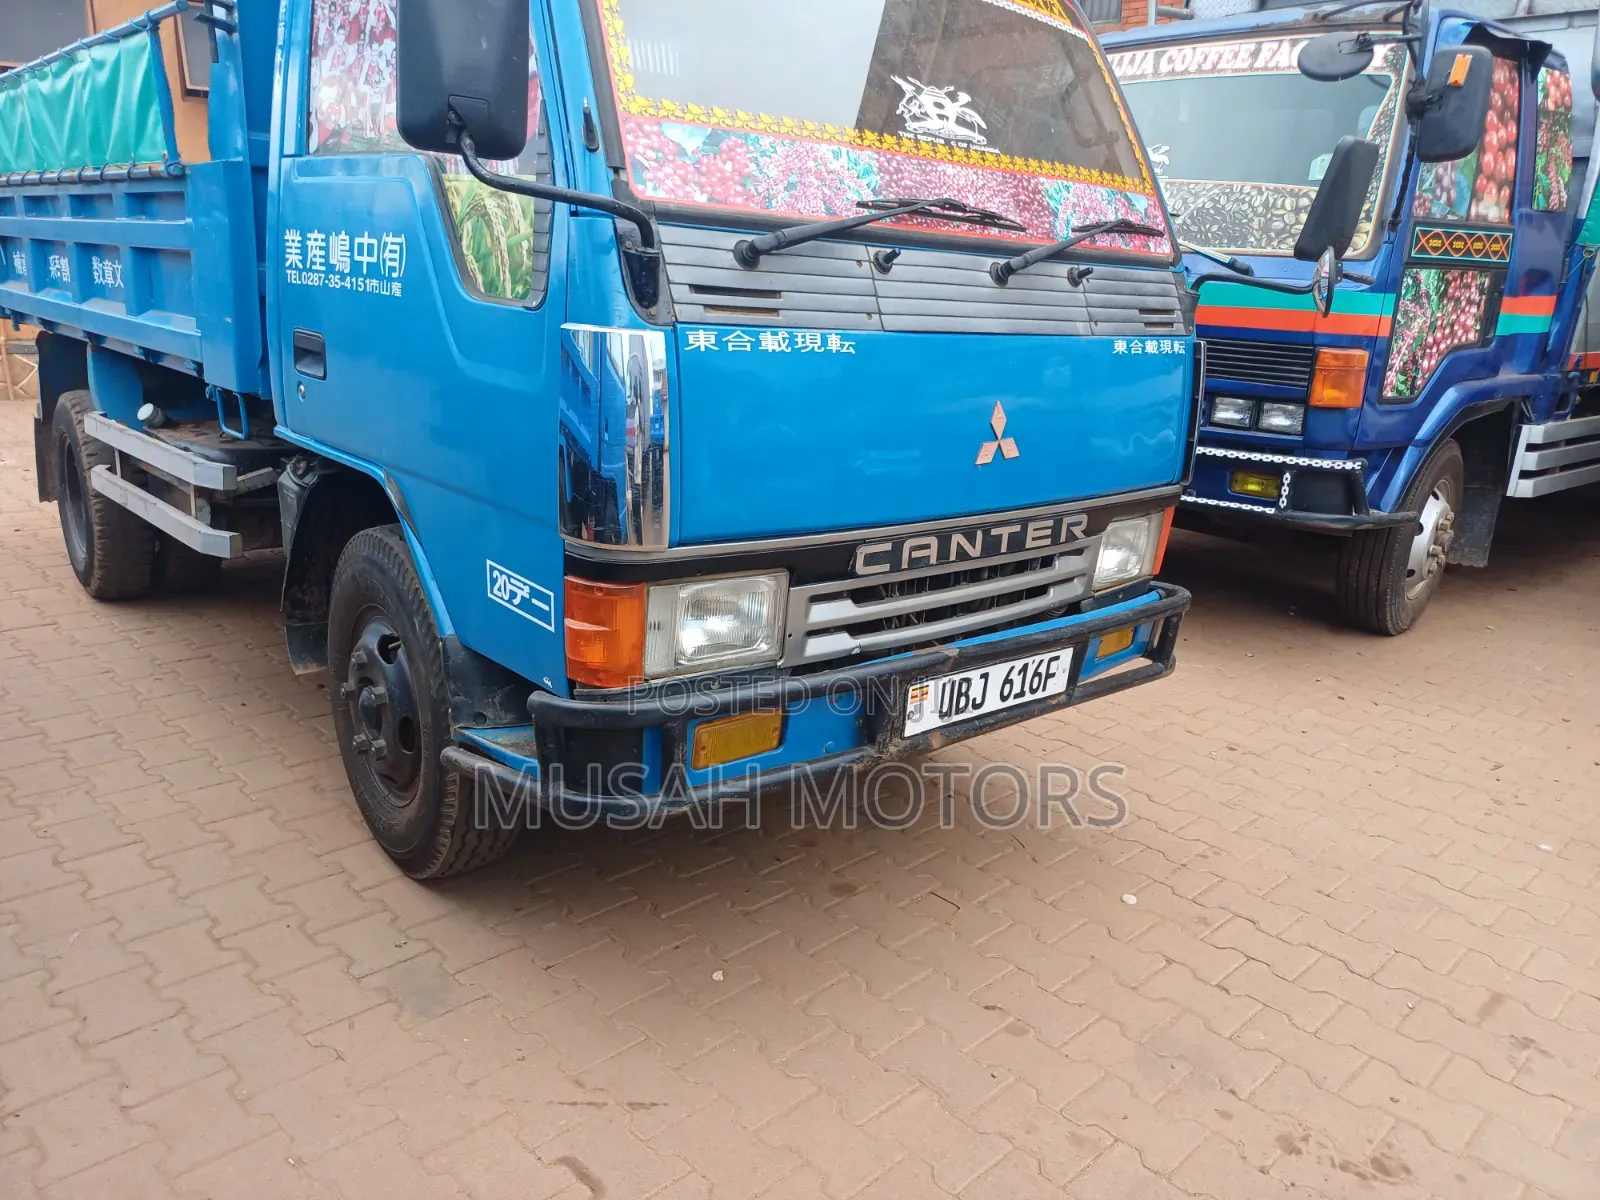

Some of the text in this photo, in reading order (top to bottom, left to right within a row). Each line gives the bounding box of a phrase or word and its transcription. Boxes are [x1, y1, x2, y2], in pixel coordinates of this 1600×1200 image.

[1159, 43, 1251, 73] COFFEE
[855, 513, 1088, 575] CANTER
[938, 655, 1060, 720] UBJ 616F
